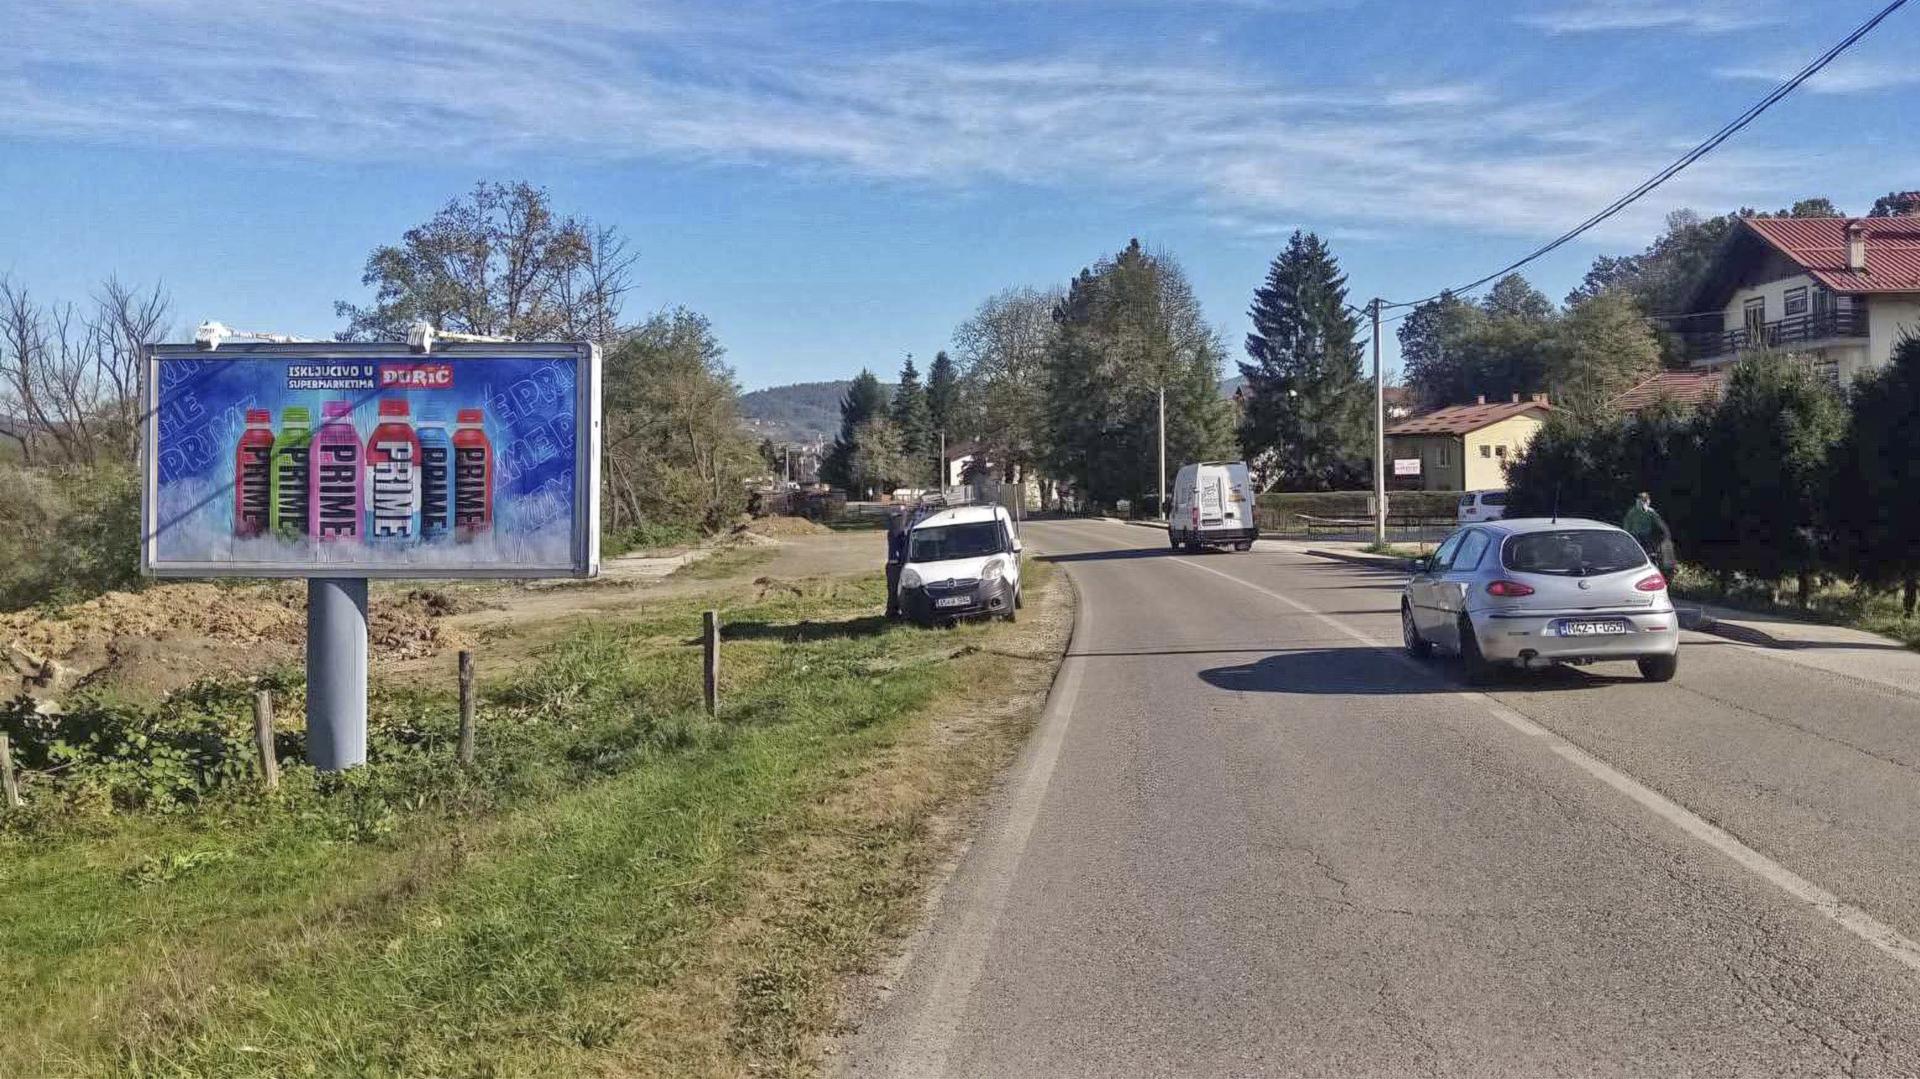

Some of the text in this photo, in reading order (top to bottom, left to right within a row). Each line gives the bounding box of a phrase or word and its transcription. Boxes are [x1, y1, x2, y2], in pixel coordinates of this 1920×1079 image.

[288, 379, 374, 389] SUPERMARKETIMA
[364, 365, 374, 377] U
[320, 445, 356, 537] PRIME
[375, 441, 413, 537] PRIME
